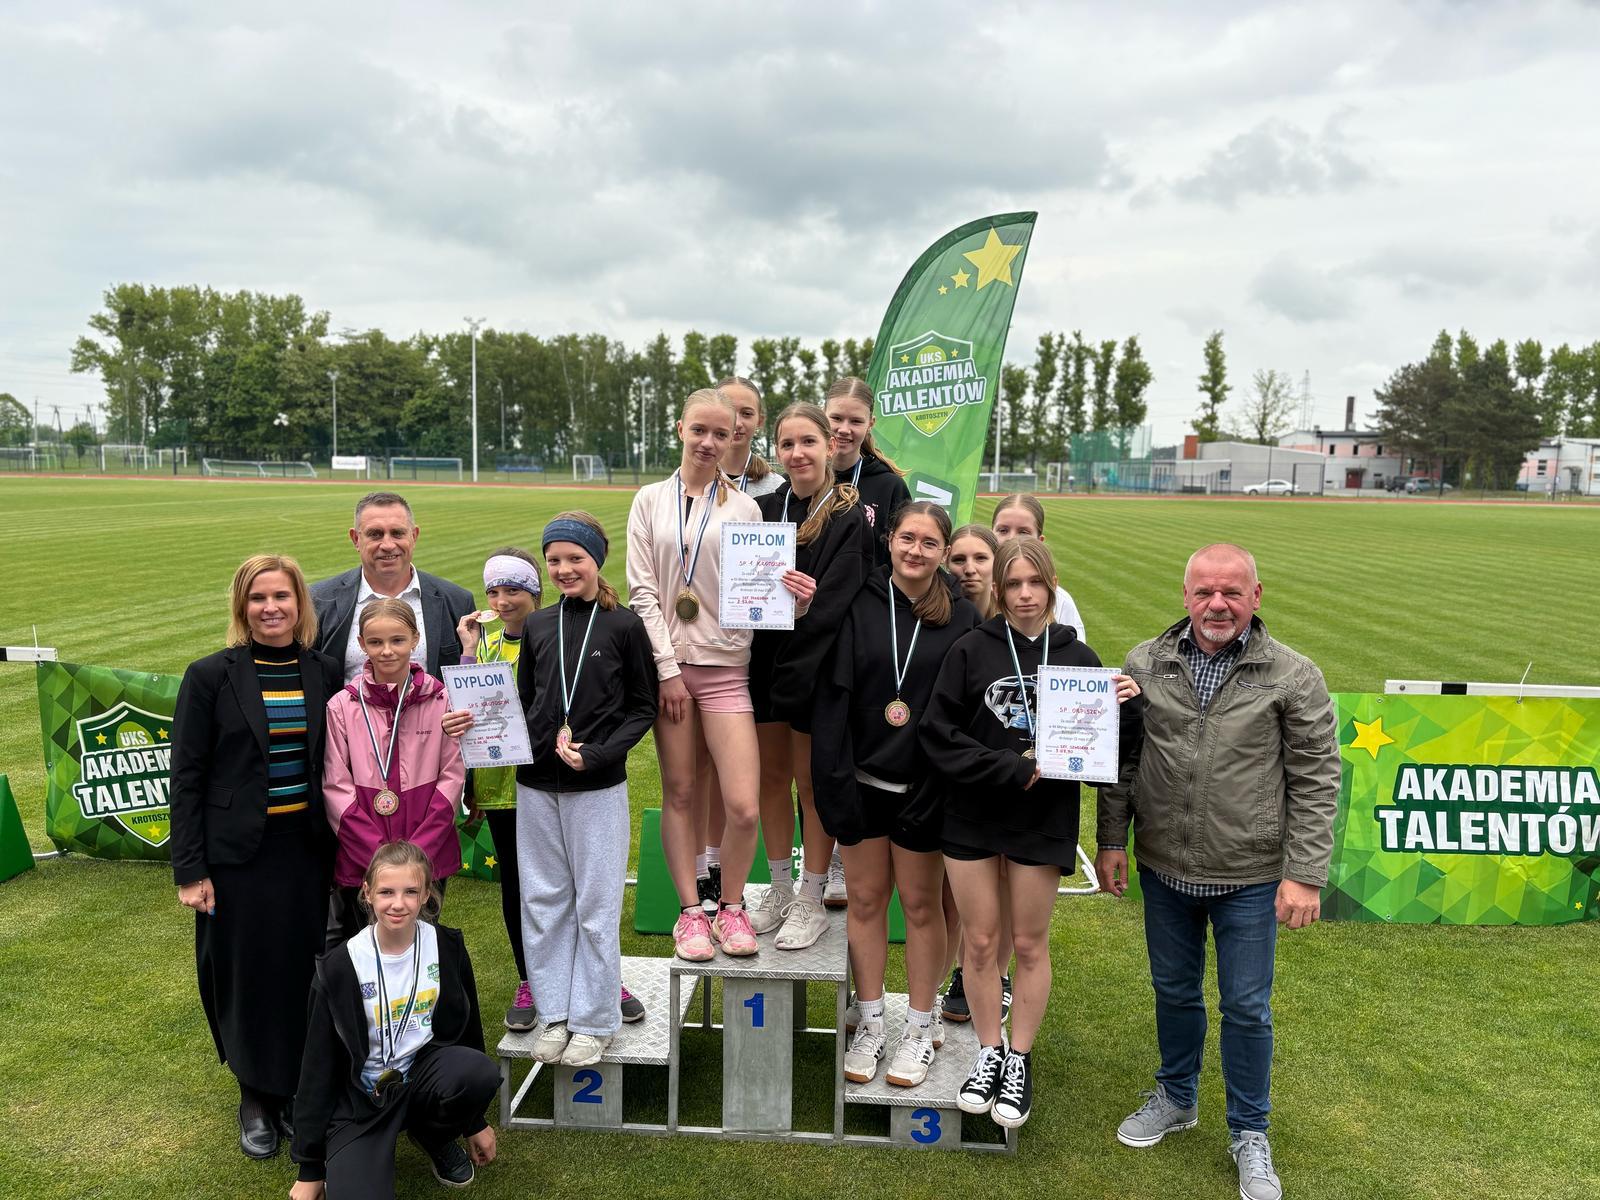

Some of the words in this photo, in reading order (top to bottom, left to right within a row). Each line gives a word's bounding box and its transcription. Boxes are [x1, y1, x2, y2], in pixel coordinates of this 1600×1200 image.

[920, 351, 942, 364] UKS
[889, 361, 975, 389] AKADEMIA
[881, 380, 984, 413] TALENTÓW
[731, 533, 785, 546] DYPLOM
[453, 673, 505, 689] DYPLOM
[1050, 678, 1109, 693] DYPLOM
[119, 730, 149, 746] UKS
[1397, 767, 1600, 804] AKADEMIA
[743, 992, 765, 1028] 1
[572, 1069, 603, 1104] 2
[910, 1108, 942, 1144] 3
